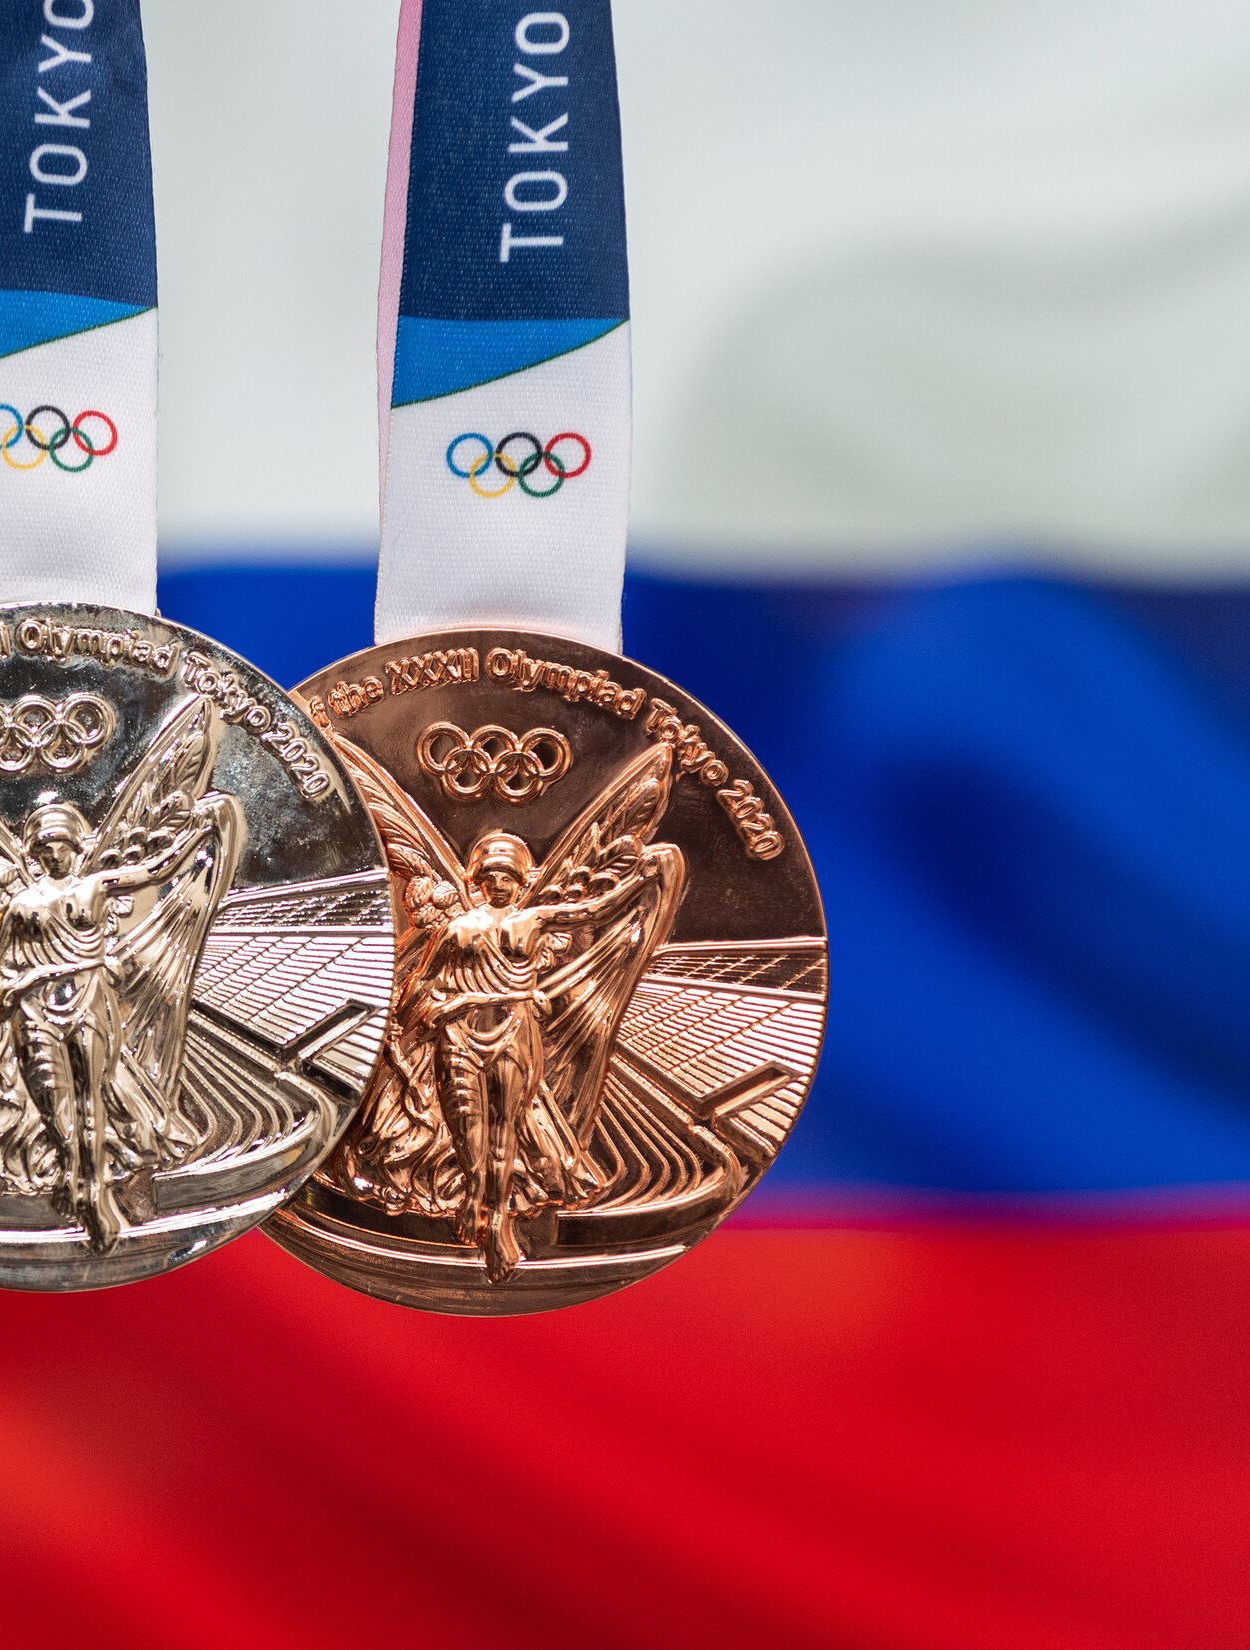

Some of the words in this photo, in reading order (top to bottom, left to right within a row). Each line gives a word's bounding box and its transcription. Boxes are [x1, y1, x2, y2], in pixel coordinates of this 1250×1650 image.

[23, 0, 94, 233] TOKYO
[500, 12, 570, 262] TOKYO
[15, 618, 180, 676] Olympiad
[181, 650, 271, 734] Tokyo
[261, 721, 331, 799] 2020
[328, 676, 385, 718] the
[385, 647, 480, 695] XXXII
[486, 647, 647, 720] Olympiad
[646, 697, 729, 786] Tokyo
[717, 779, 785, 860] 2020
